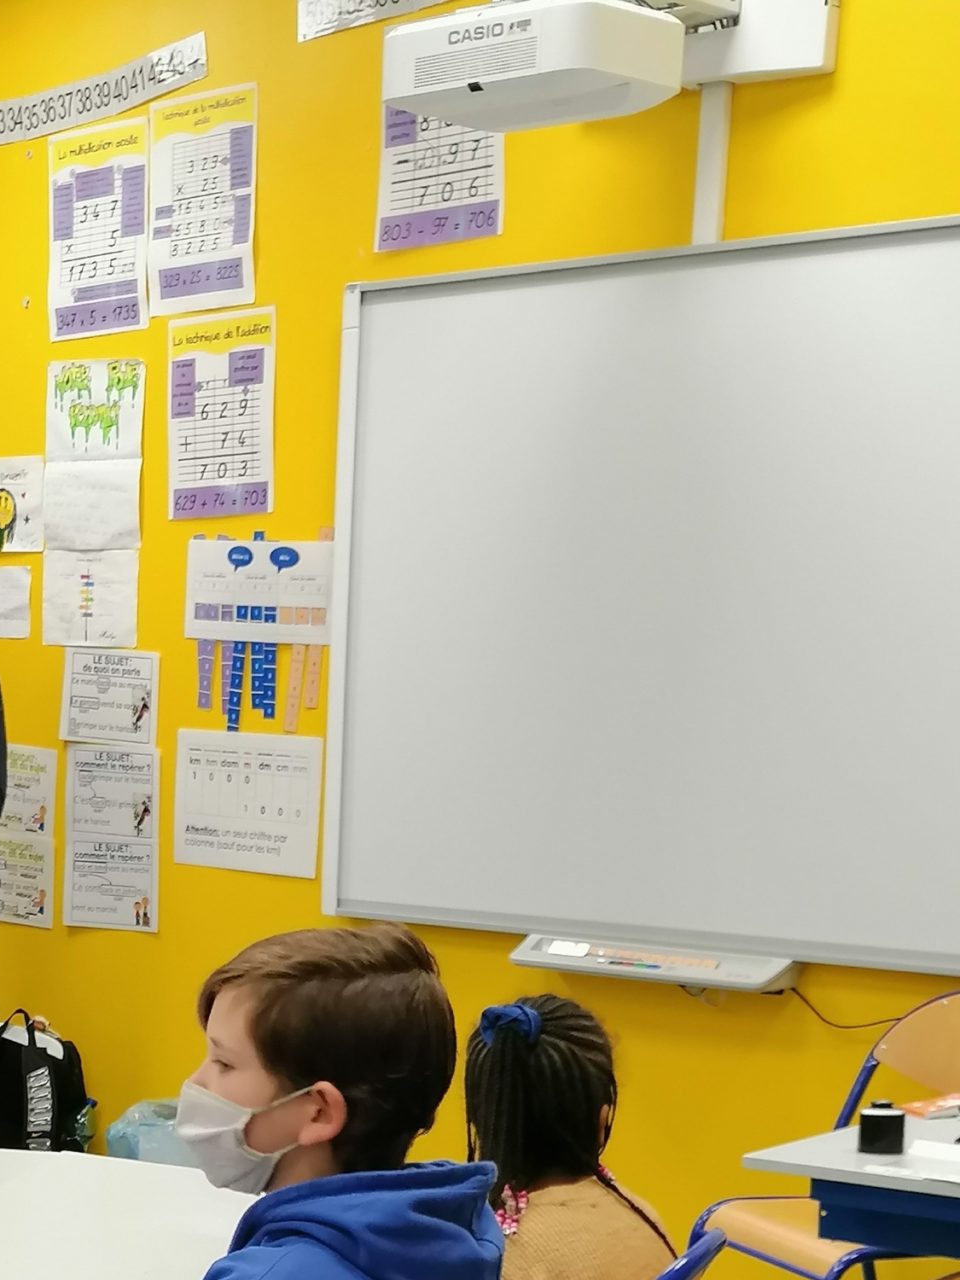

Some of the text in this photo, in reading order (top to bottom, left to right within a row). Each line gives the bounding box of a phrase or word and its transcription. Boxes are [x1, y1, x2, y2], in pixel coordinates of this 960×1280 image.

[448, 22, 504, 45] CASIO
[7, 105, 22, 132] 34
[24, 104, 39, 131] 35
[40, 97, 56, 124] 36
[57, 92, 73, 119] 37
[75, 87, 92, 114] 38
[94, 81, 111, 109] 39
[113, 75, 129, 103] 40
[130, 65, 145, 93] 41
[381, 222, 412, 242] 803
[468, 208, 496, 230] 706
[174, 494, 197, 512] 629
[214, 492, 225, 508] 74
[243, 488, 268, 507] 703
[93, 655, 103, 665] LE
[83, 664, 92, 673] de
[93, 666, 110, 674] quoi
[95, 752, 105, 761] LE
[75, 761, 109, 770] comment
[189, 756, 201, 765] km
[221, 759, 239, 768] dam
[259, 762, 272, 770] dm
[276, 764, 289, 772] cm
[94, 843, 104, 852] LE
[74, 852, 108, 860] comment
